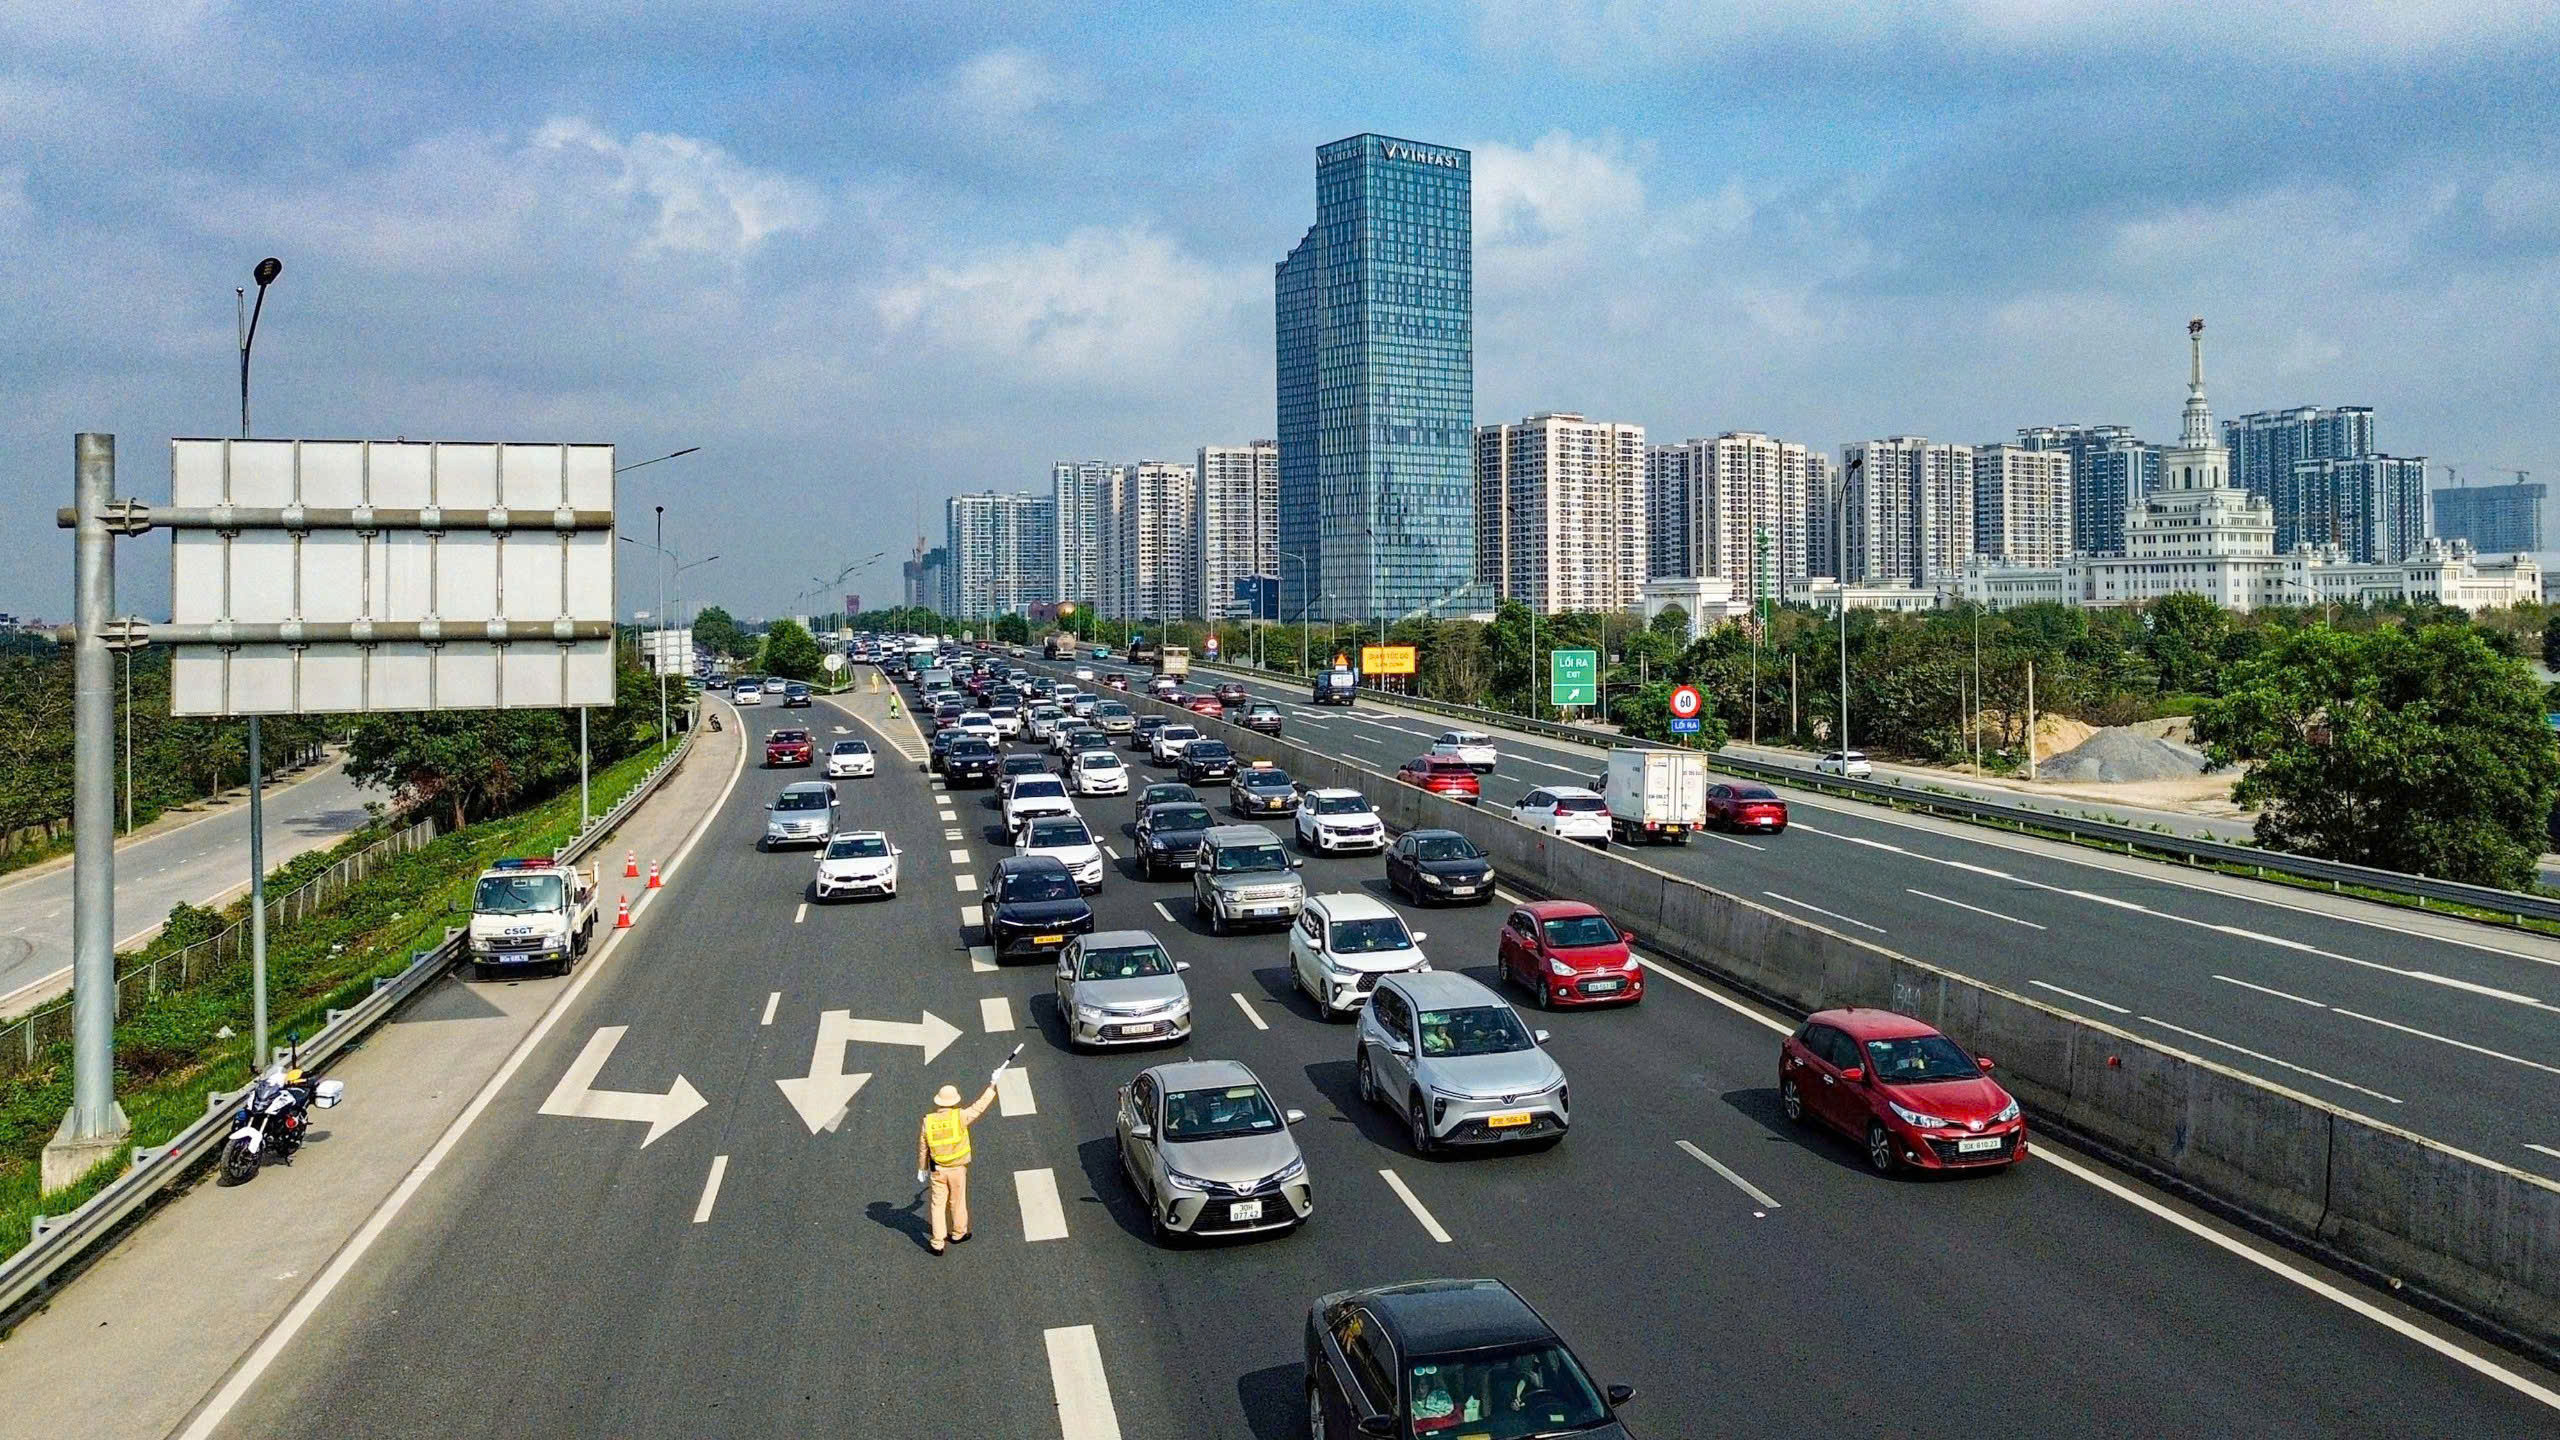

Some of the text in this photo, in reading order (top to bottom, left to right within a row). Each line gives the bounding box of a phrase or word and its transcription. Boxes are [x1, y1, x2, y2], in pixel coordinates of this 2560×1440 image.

[1400, 147, 1461, 168] VINFAST
[1575, 658, 1589, 668] RA
[1566, 671, 1581, 679] EXIT
[1680, 695, 1692, 708] 60
[504, 927, 534, 935] CSGT
